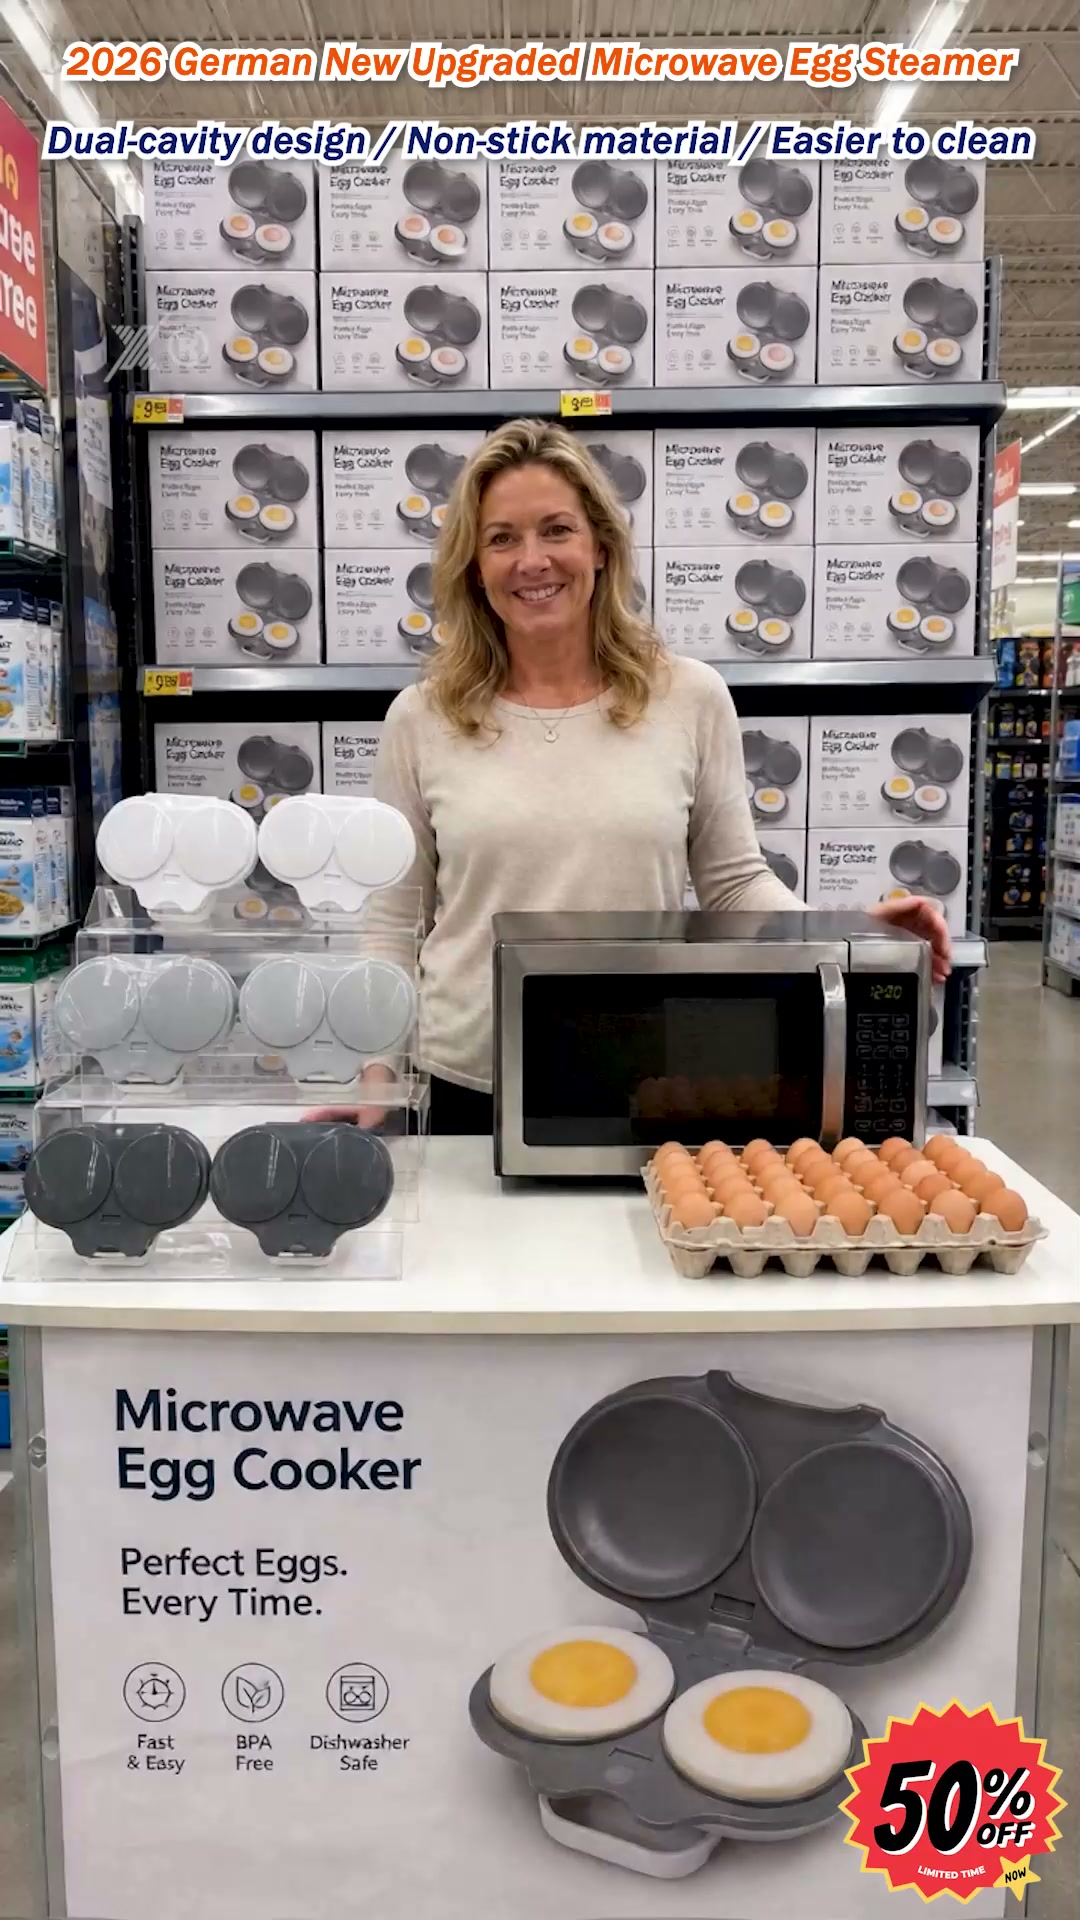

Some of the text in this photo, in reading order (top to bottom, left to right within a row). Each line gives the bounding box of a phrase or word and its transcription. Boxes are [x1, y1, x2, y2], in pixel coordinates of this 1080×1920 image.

[114, 1386, 405, 1434] Microwave
[117, 1445, 423, 1503] Egg Cooker
[121, 1547, 347, 1584] Perfect Eggs.
[122, 1587, 322, 1623] Every Time.
[137, 1733, 175, 1751] Fast
[236, 1734, 273, 1750] BPA
[310, 1733, 410, 1751] Dishwasher
[127, 1754, 186, 1775] & Easy
[236, 1754, 274, 1771] Free
[340, 1754, 379, 1771] Safe
